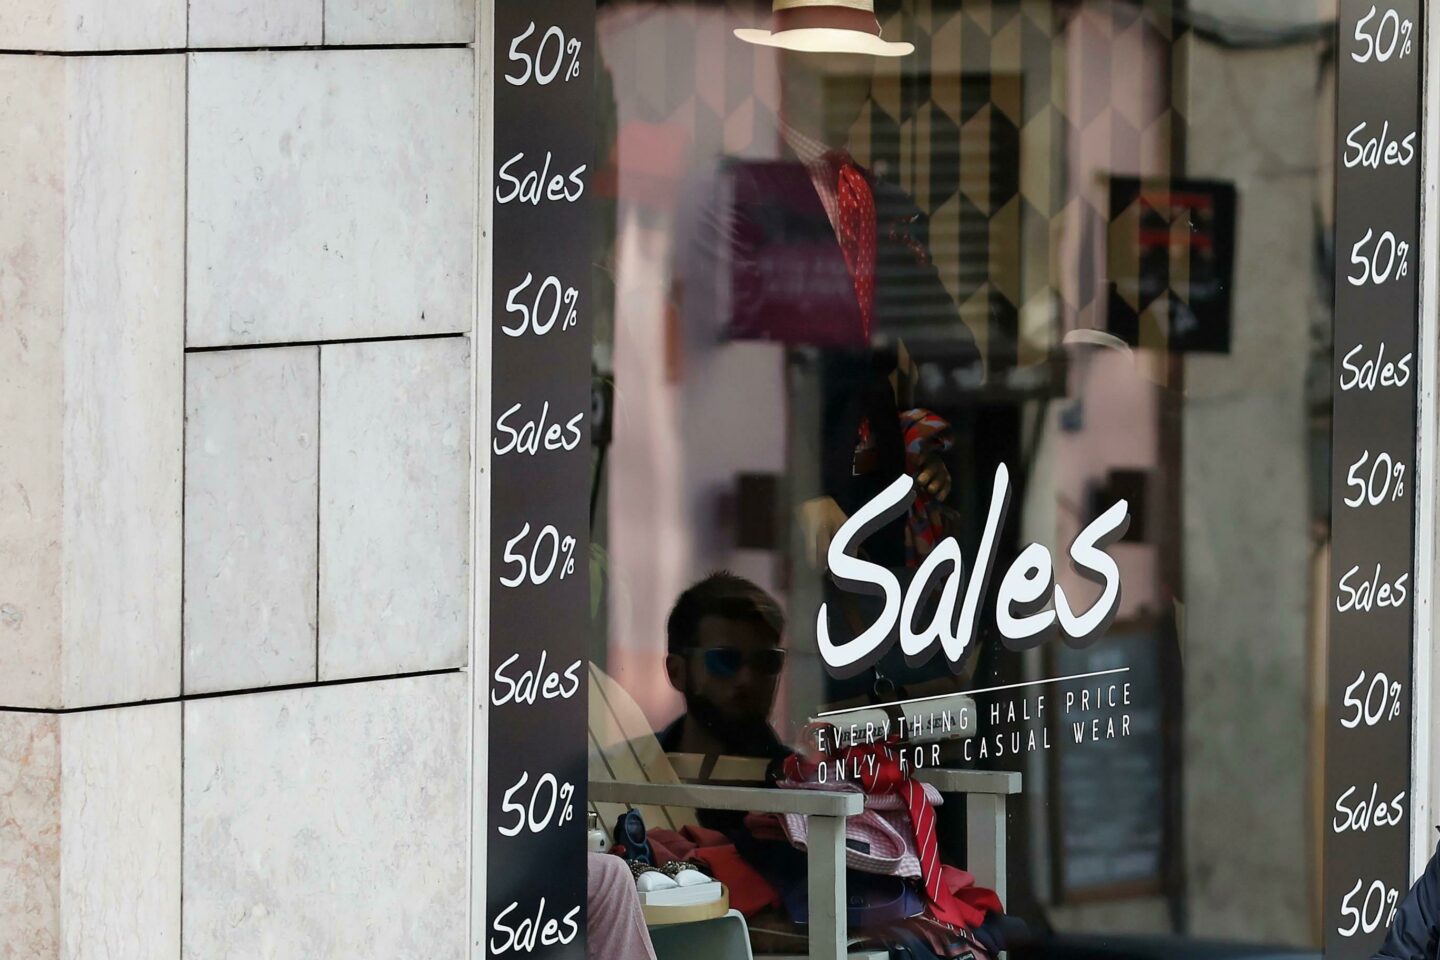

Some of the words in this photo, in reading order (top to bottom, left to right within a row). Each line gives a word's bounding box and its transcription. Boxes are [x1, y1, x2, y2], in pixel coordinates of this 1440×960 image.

[504, 21, 582, 86] 50%
[1351, 5, 1413, 63] 50%
[1343, 120, 1416, 169] Sales
[495, 151, 586, 206] Sales
[1347, 228, 1409, 286] 50%
[501, 272, 579, 337] 50%
[1339, 342, 1413, 391] Sales
[493, 400, 584, 456] Sales
[1343, 449, 1406, 508] 50%
[499, 522, 577, 588] 50%
[816, 462, 1130, 675] Sales
[1336, 563, 1409, 613] Sales
[491, 649, 582, 706] Sales
[1340, 670, 1402, 729] 50%
[818, 707, 968, 752] EVERYTHING
[990, 695, 1045, 726] HALF
[1066, 683, 1131, 714] PRICE
[818, 754, 877, 785] ONLY
[900, 744, 941, 773] FOR
[963, 727, 1051, 761] CASUAL
[1073, 714, 1131, 744] WEAR
[497, 770, 575, 837] 50%
[1333, 782, 1406, 833] Sales
[490, 897, 581, 955] Sales
[1337, 878, 1398, 937] 50%
